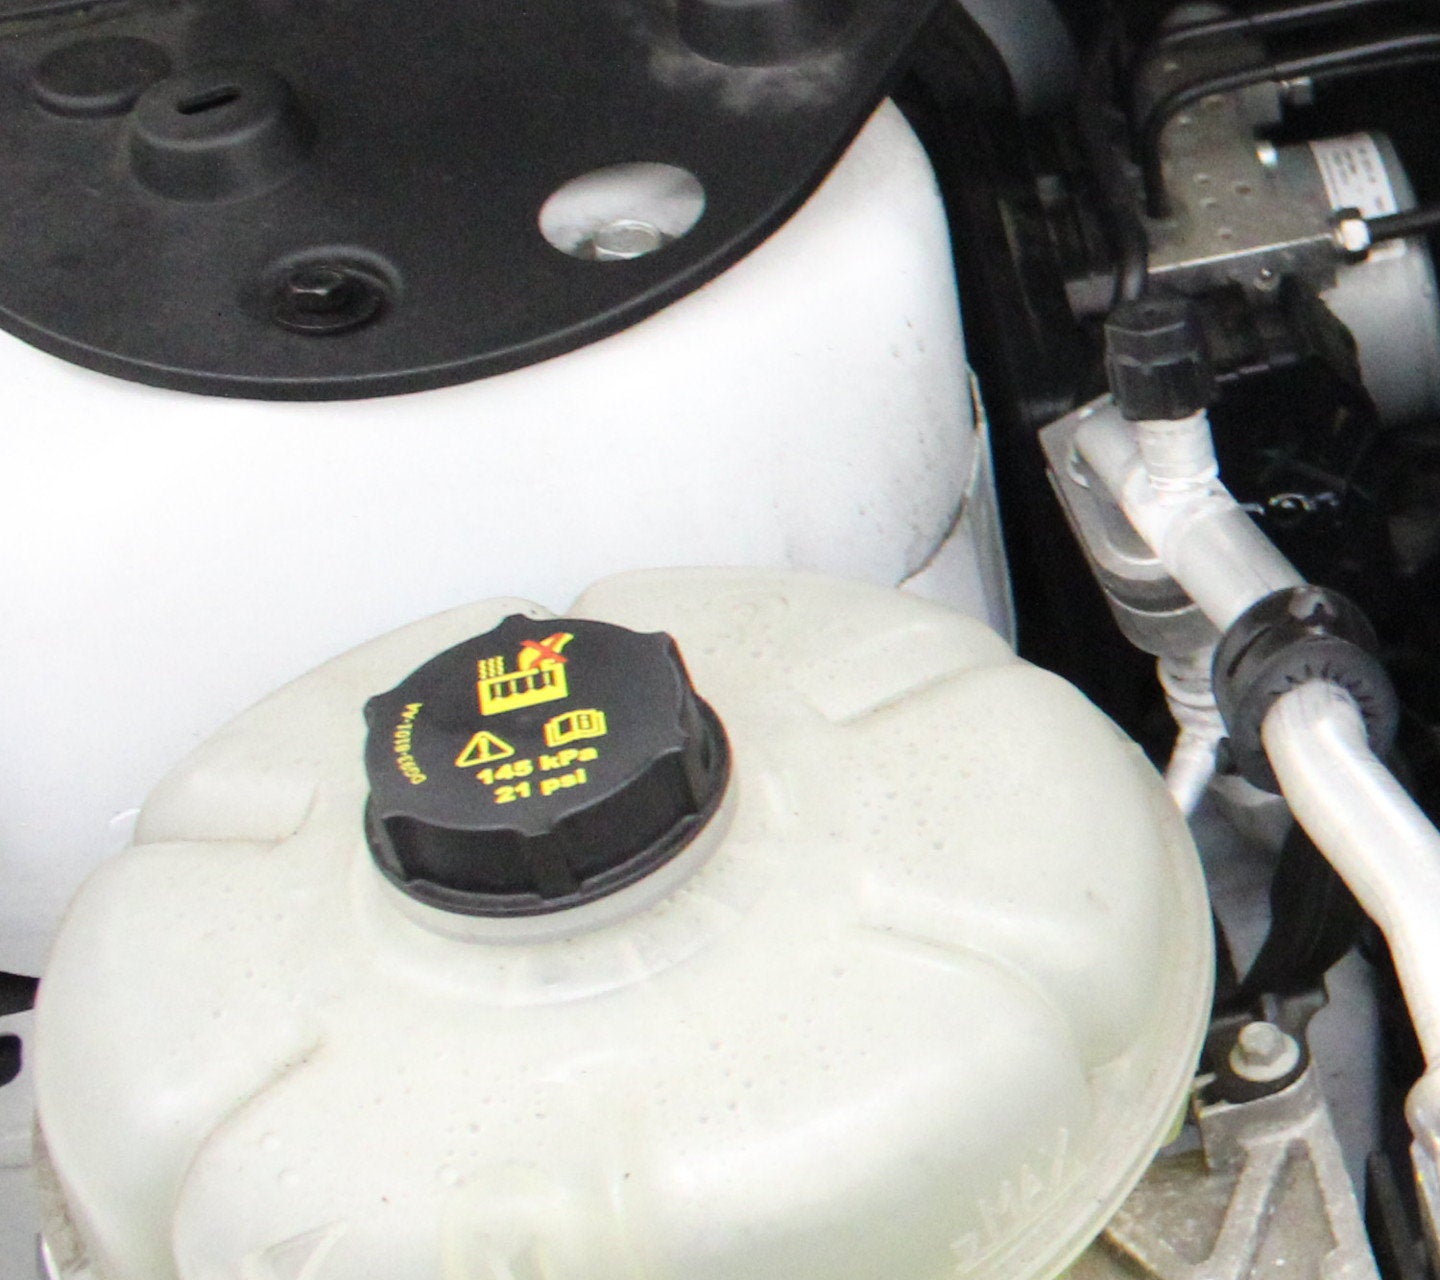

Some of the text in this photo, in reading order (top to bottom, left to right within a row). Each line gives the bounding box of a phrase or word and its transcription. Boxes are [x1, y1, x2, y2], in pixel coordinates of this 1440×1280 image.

[476, 747, 598, 785] 145 kPa
[494, 767, 587, 804] 21 psi
